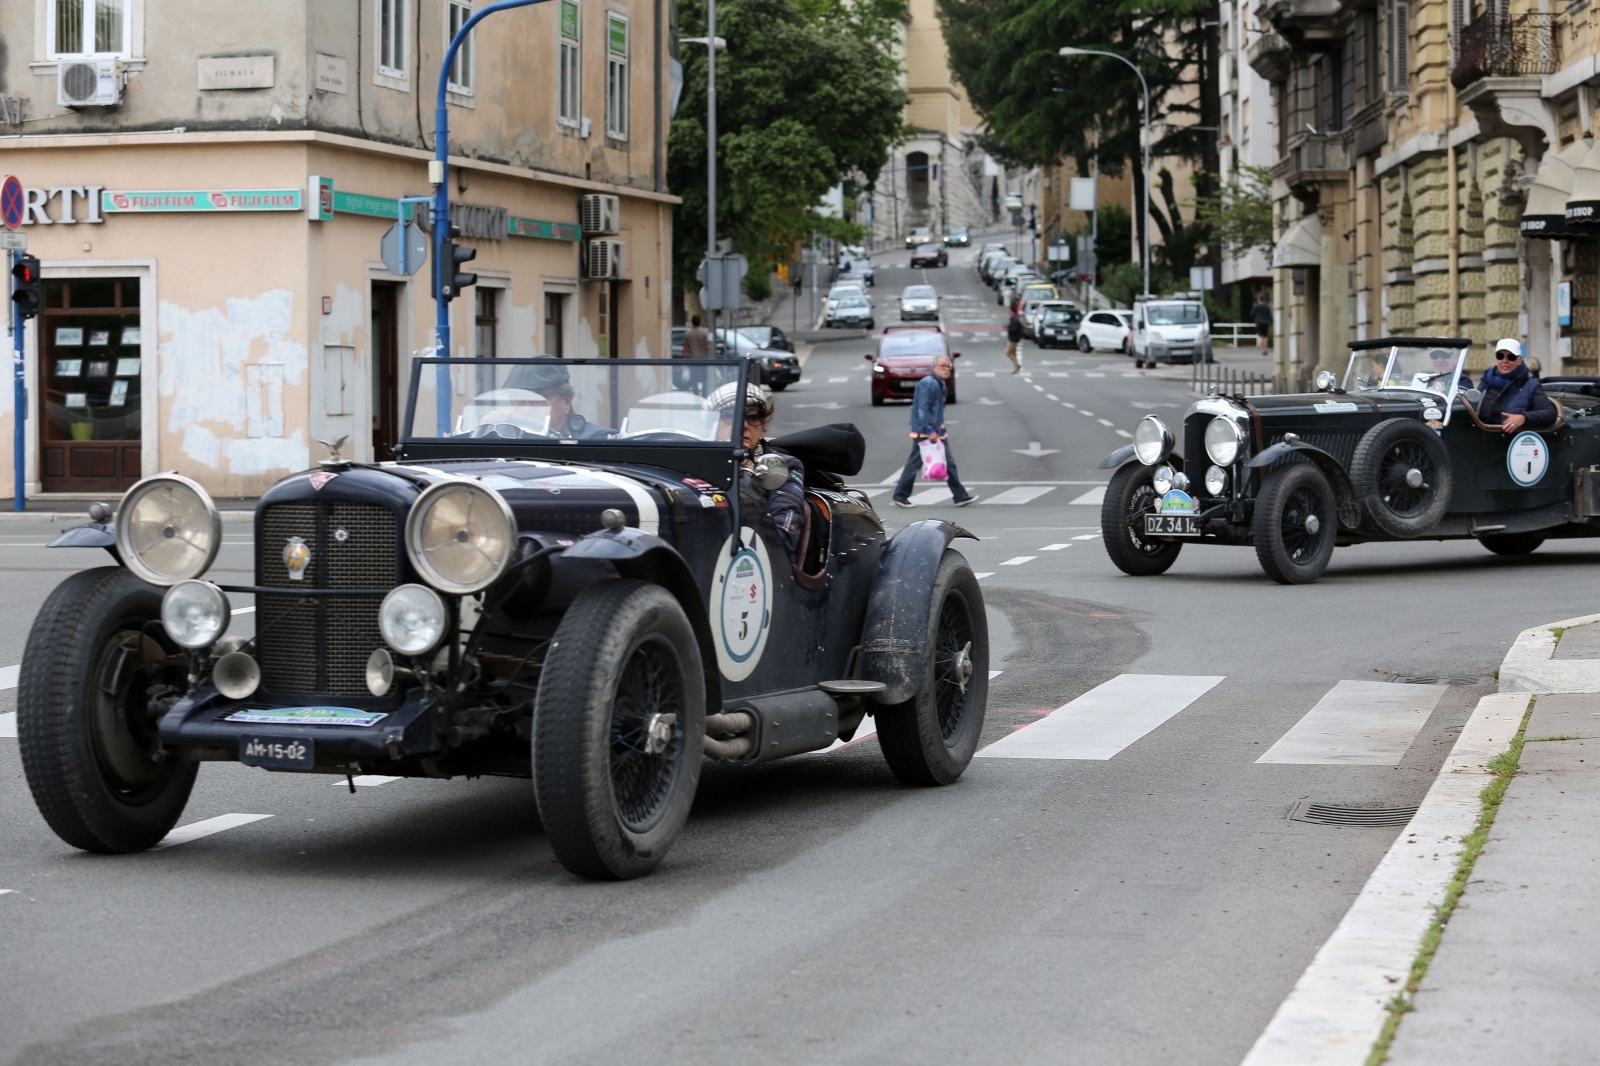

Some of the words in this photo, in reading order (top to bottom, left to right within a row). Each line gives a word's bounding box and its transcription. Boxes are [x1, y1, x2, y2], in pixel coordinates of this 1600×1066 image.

[215, 69, 255, 78] FIUMARA
[21, 186, 104, 225] RTI
[1573, 206, 1594, 217] SHOP
[1527, 220, 1546, 231] SHOP
[1147, 517, 1163, 532] DZ
[1166, 517, 1182, 533] 34
[738, 611, 749, 641] 5
[245, 742, 306, 760] AM-15-02
